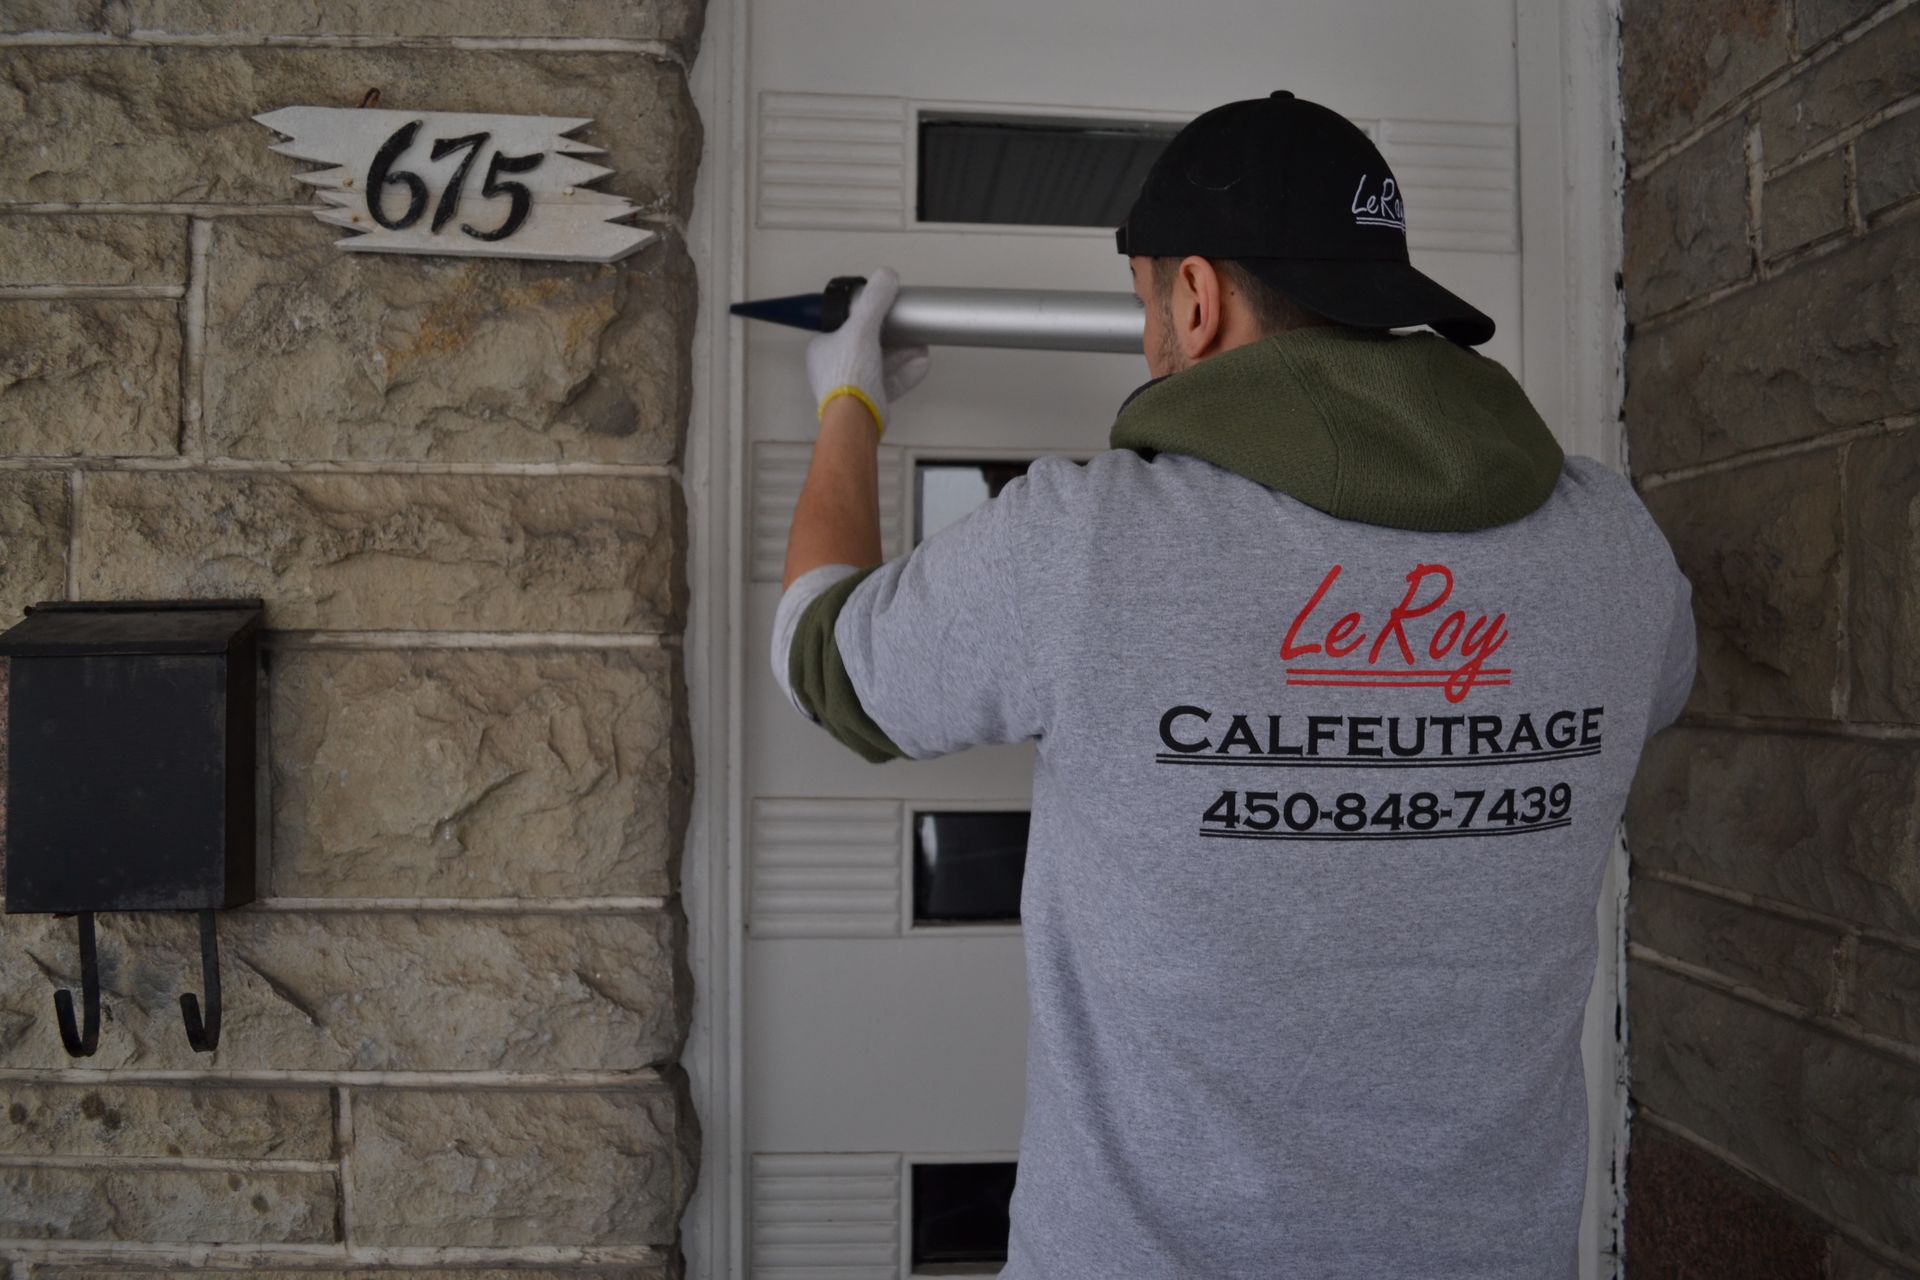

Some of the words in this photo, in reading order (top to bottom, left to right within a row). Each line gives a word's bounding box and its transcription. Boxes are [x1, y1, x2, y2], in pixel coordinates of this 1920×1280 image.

[366, 119, 545, 242] 675
[1280, 564, 1509, 703] LeRoy
[1159, 705, 1604, 757] CALFEUTRAGE
[1202, 782, 1572, 832] 450-848-7439
